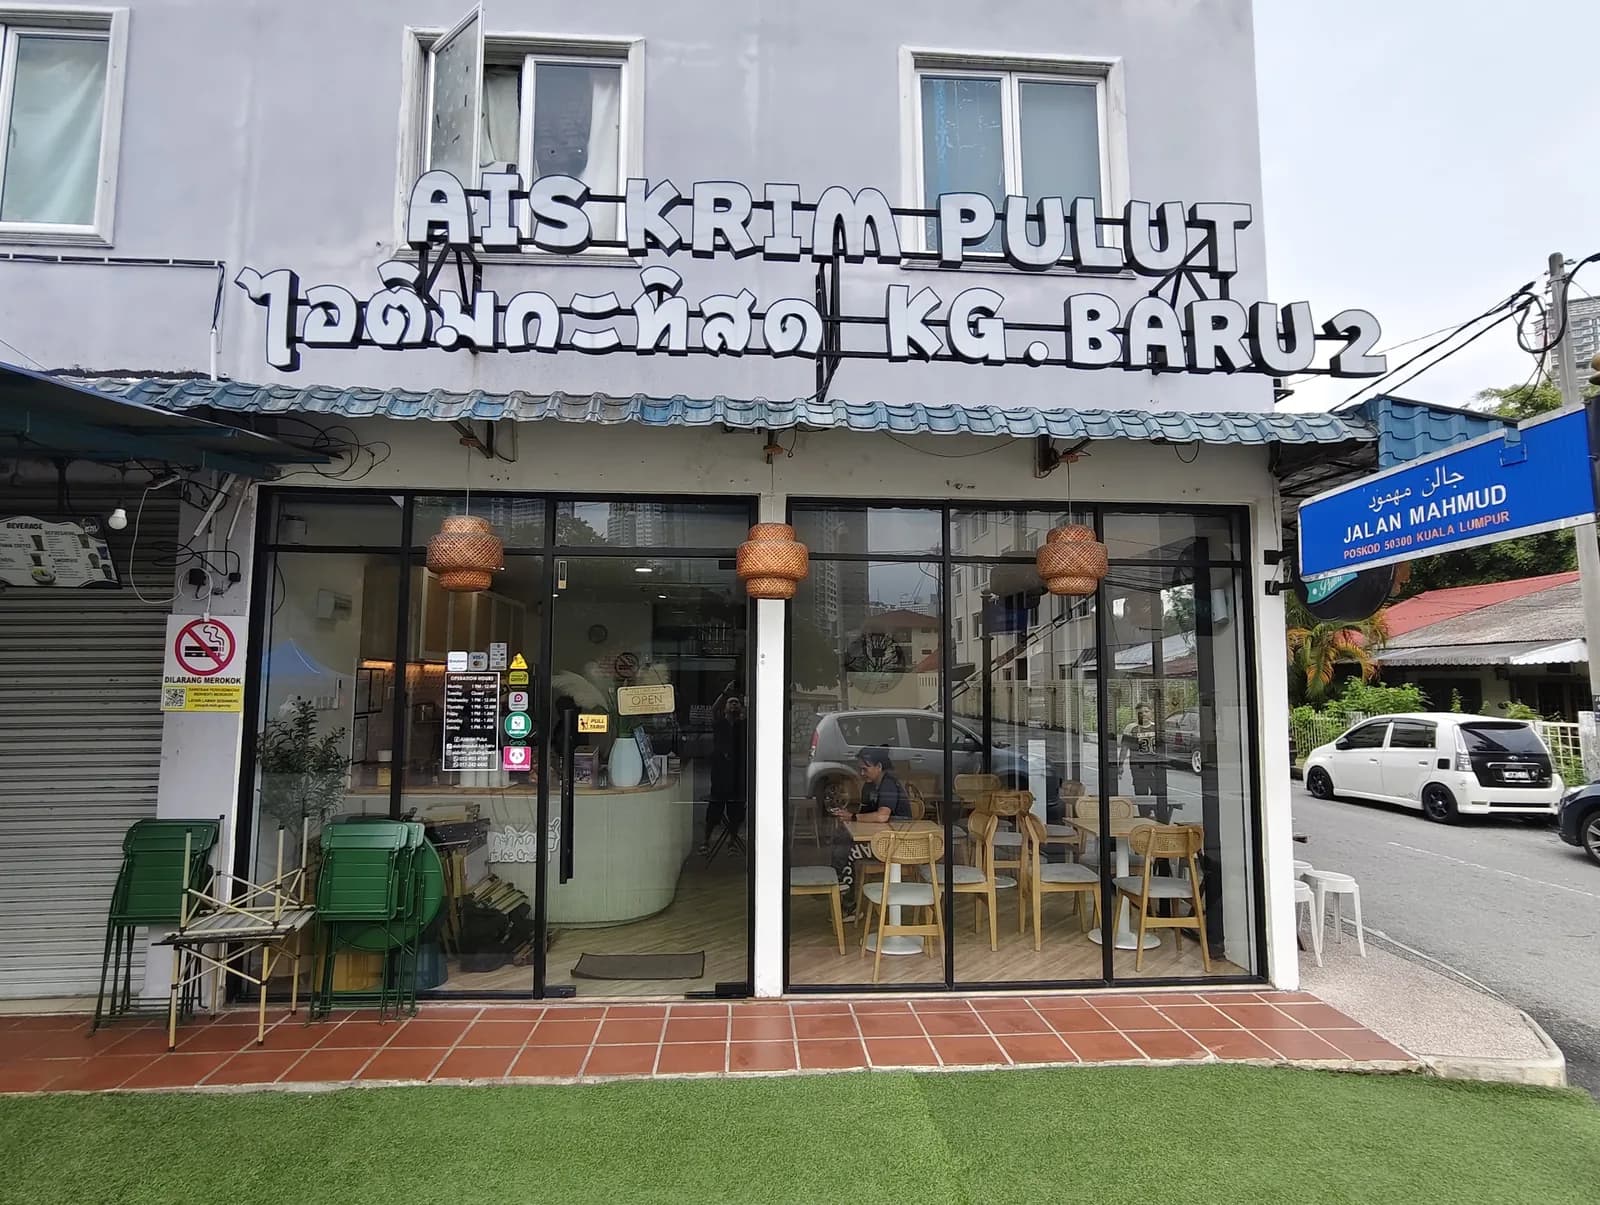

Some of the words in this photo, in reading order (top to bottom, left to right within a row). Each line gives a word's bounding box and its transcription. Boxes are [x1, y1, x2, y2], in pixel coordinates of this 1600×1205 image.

[407, 169, 592, 253] AIS
[625, 178, 901, 264] KRIM
[937, 191, 1252, 278] PULUT
[235, 259, 823, 372] ไอติมกะทิสด
[886, 284, 1050, 367] KG.
[1064, 292, 1315, 377] BARU
[1322, 308, 1387, 378] 2
[1368, 487, 1412, 513] مهمود
[1422, 464, 1465, 497] جالن
[6, 522, 44, 530] BEVERAGE
[1344, 512, 1402, 544] JALAN
[1409, 484, 1507, 526] MAHMUD
[1344, 542, 1381, 560] POSKOD
[1384, 534, 1413, 551] 50300
[1416, 524, 1455, 543] KUALA
[1459, 511, 1511, 533] LUMPUR
[164, 676, 202, 684] DILARANG
[631, 695, 663, 706] OPEN
